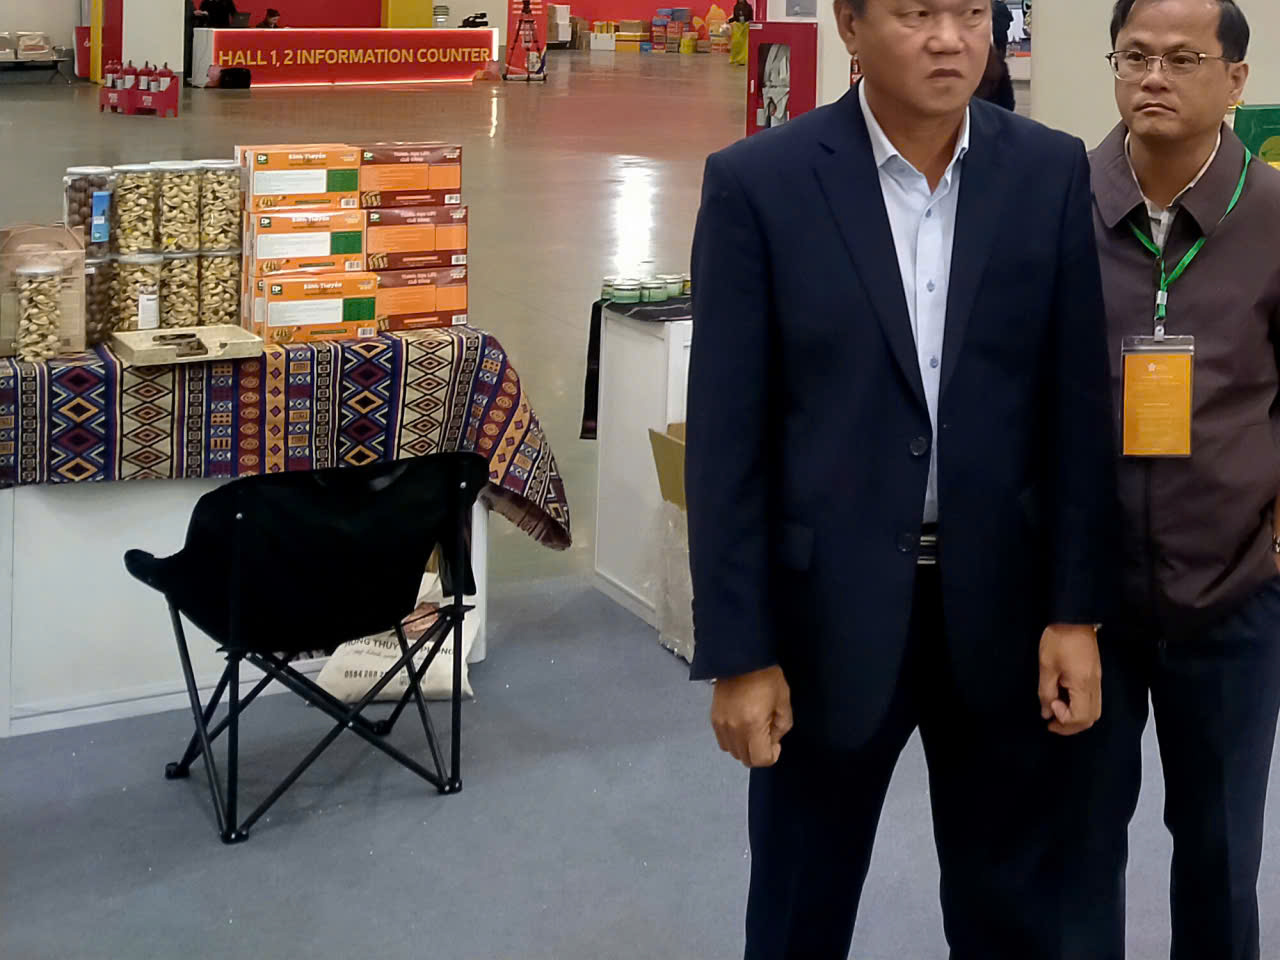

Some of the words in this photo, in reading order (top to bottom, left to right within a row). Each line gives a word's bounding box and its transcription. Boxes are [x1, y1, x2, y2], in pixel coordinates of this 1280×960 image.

[218, 49, 267, 66] HALL
[283, 49, 294, 65] 2
[296, 47, 413, 65] INFORMATION
[416, 46, 490, 63] COUNTER
